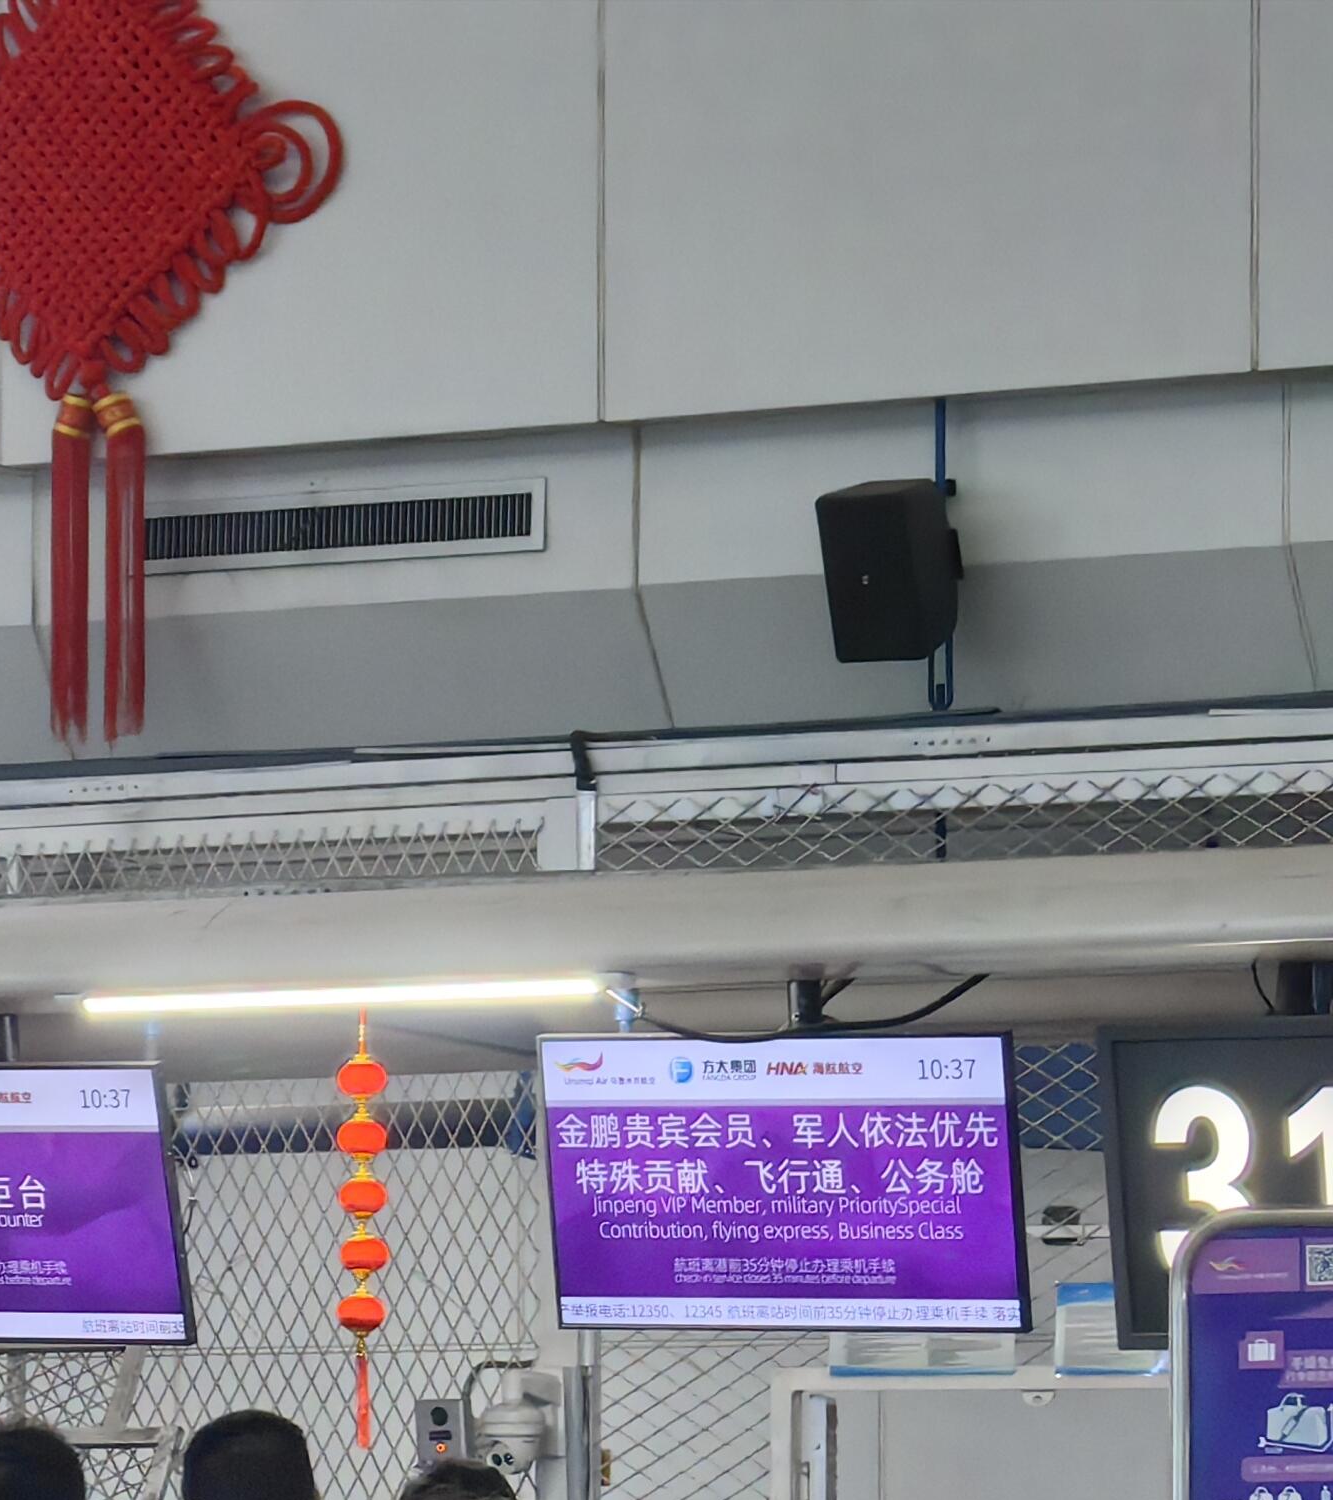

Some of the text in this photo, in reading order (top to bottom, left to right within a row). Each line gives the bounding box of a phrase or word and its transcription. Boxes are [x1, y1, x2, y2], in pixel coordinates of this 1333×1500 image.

[917, 1059, 976, 1080] 10:37
[79, 1089, 131, 1110] 10:37
[556, 1112, 999, 1149] 金鹏贵宾会员、军人依法优先
[576, 1158, 985, 1195] 特殊贡献、飞行通、公务舱
[592, 1197, 658, 1217] Jinpeng
[661, 1197, 687, 1210] VIP
[691, 1197, 767, 1217] Member,
[771, 1197, 834, 1217] military
[599, 1221, 965, 1242] Contribution, flying express, Business Class
